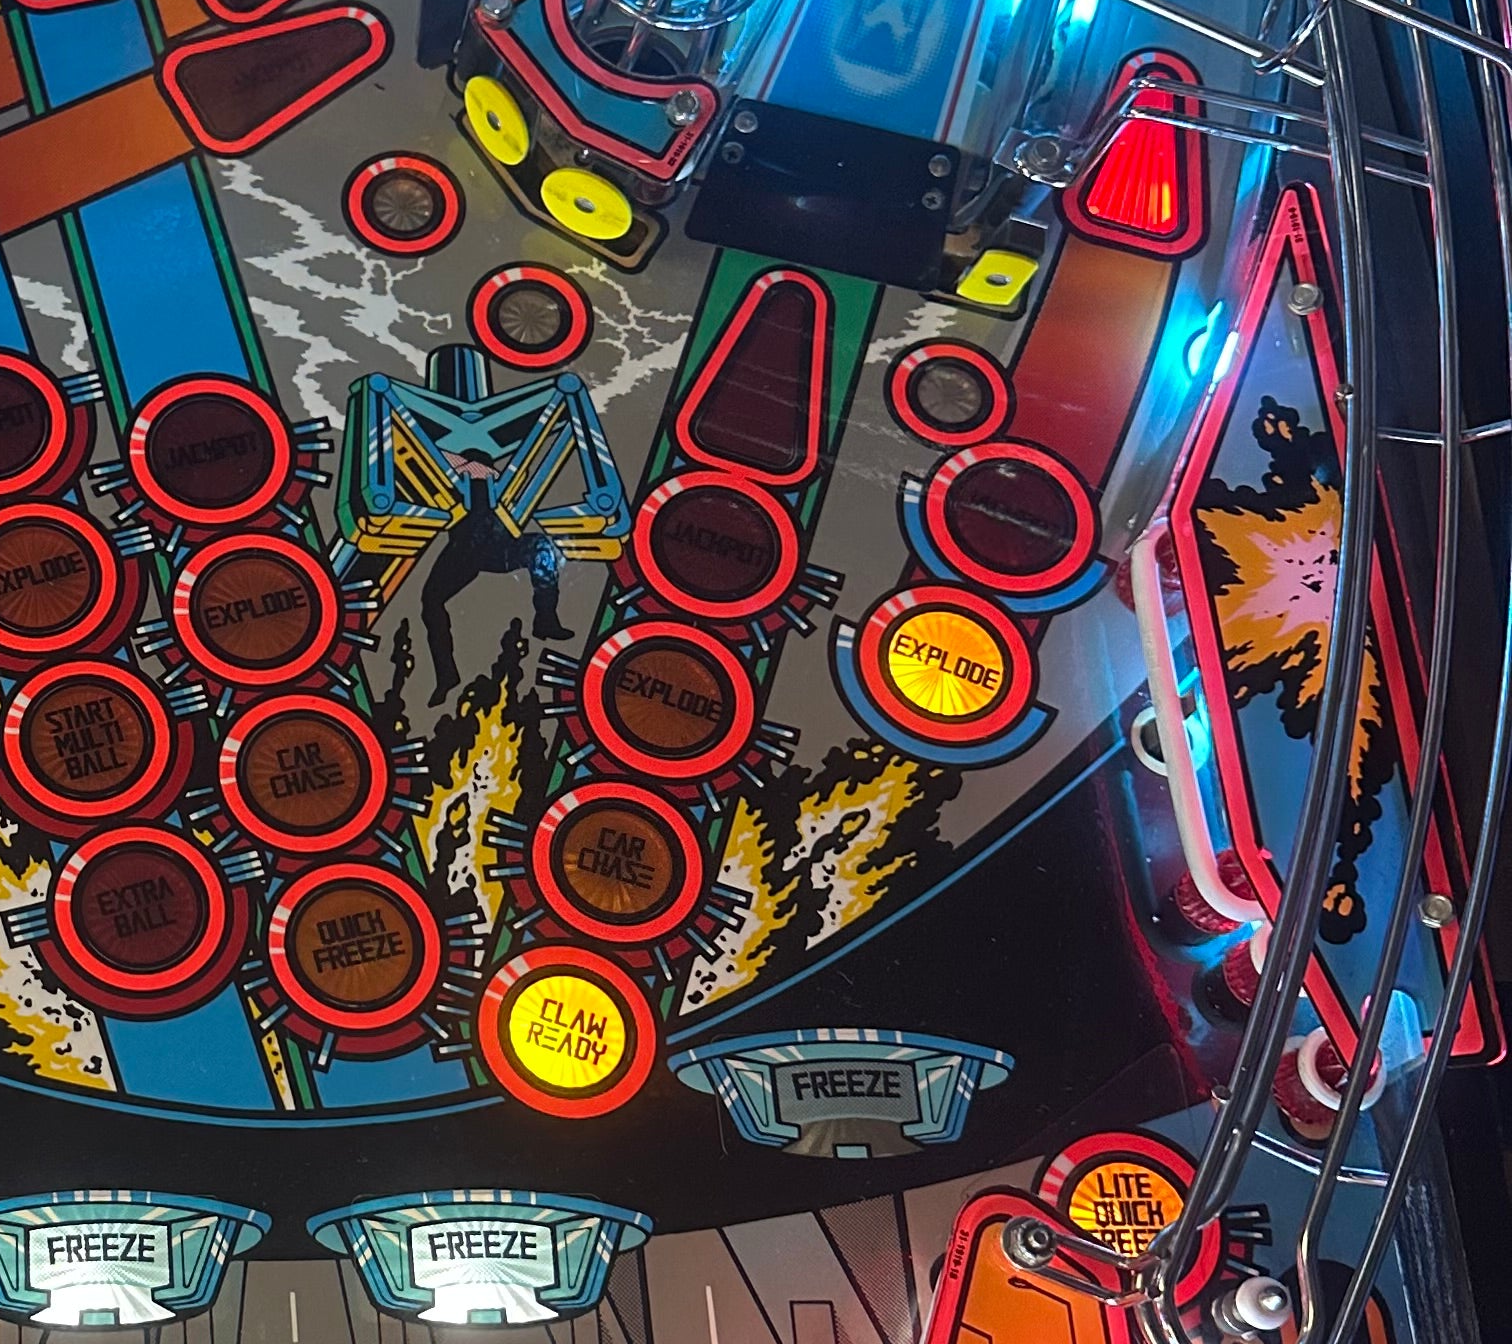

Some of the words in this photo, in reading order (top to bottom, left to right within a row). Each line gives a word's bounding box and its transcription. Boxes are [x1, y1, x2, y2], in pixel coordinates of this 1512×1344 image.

[165, 431, 258, 470] JACKPOT
[204, 587, 307, 630] EXPLODE
[894, 634, 1000, 691] EXPLODE
[616, 669, 724, 722] EXPLODE
[44, 698, 115, 733] START
[53, 721, 124, 758] MULTI
[276, 742, 325, 771] CAR
[66, 747, 127, 780] BALL
[270, 766, 345, 800] CHASE
[598, 828, 646, 861] CAR
[577, 848, 655, 889] CHASE
[96, 877, 174, 916] EXTRA
[114, 906, 176, 938] BALL
[317, 910, 386, 946] QUICK
[312, 933, 405, 973] FREEZE
[539, 998, 607, 1039] CLAW
[526, 1021, 607, 1065] READY
[792, 1069, 901, 1102] FREEZE
[1097, 1173, 1153, 1198] LITE
[1094, 1200, 1164, 1227] QUICK
[48, 1232, 155, 1264] FREEZE
[428, 1231, 537, 1262] FREEZE
